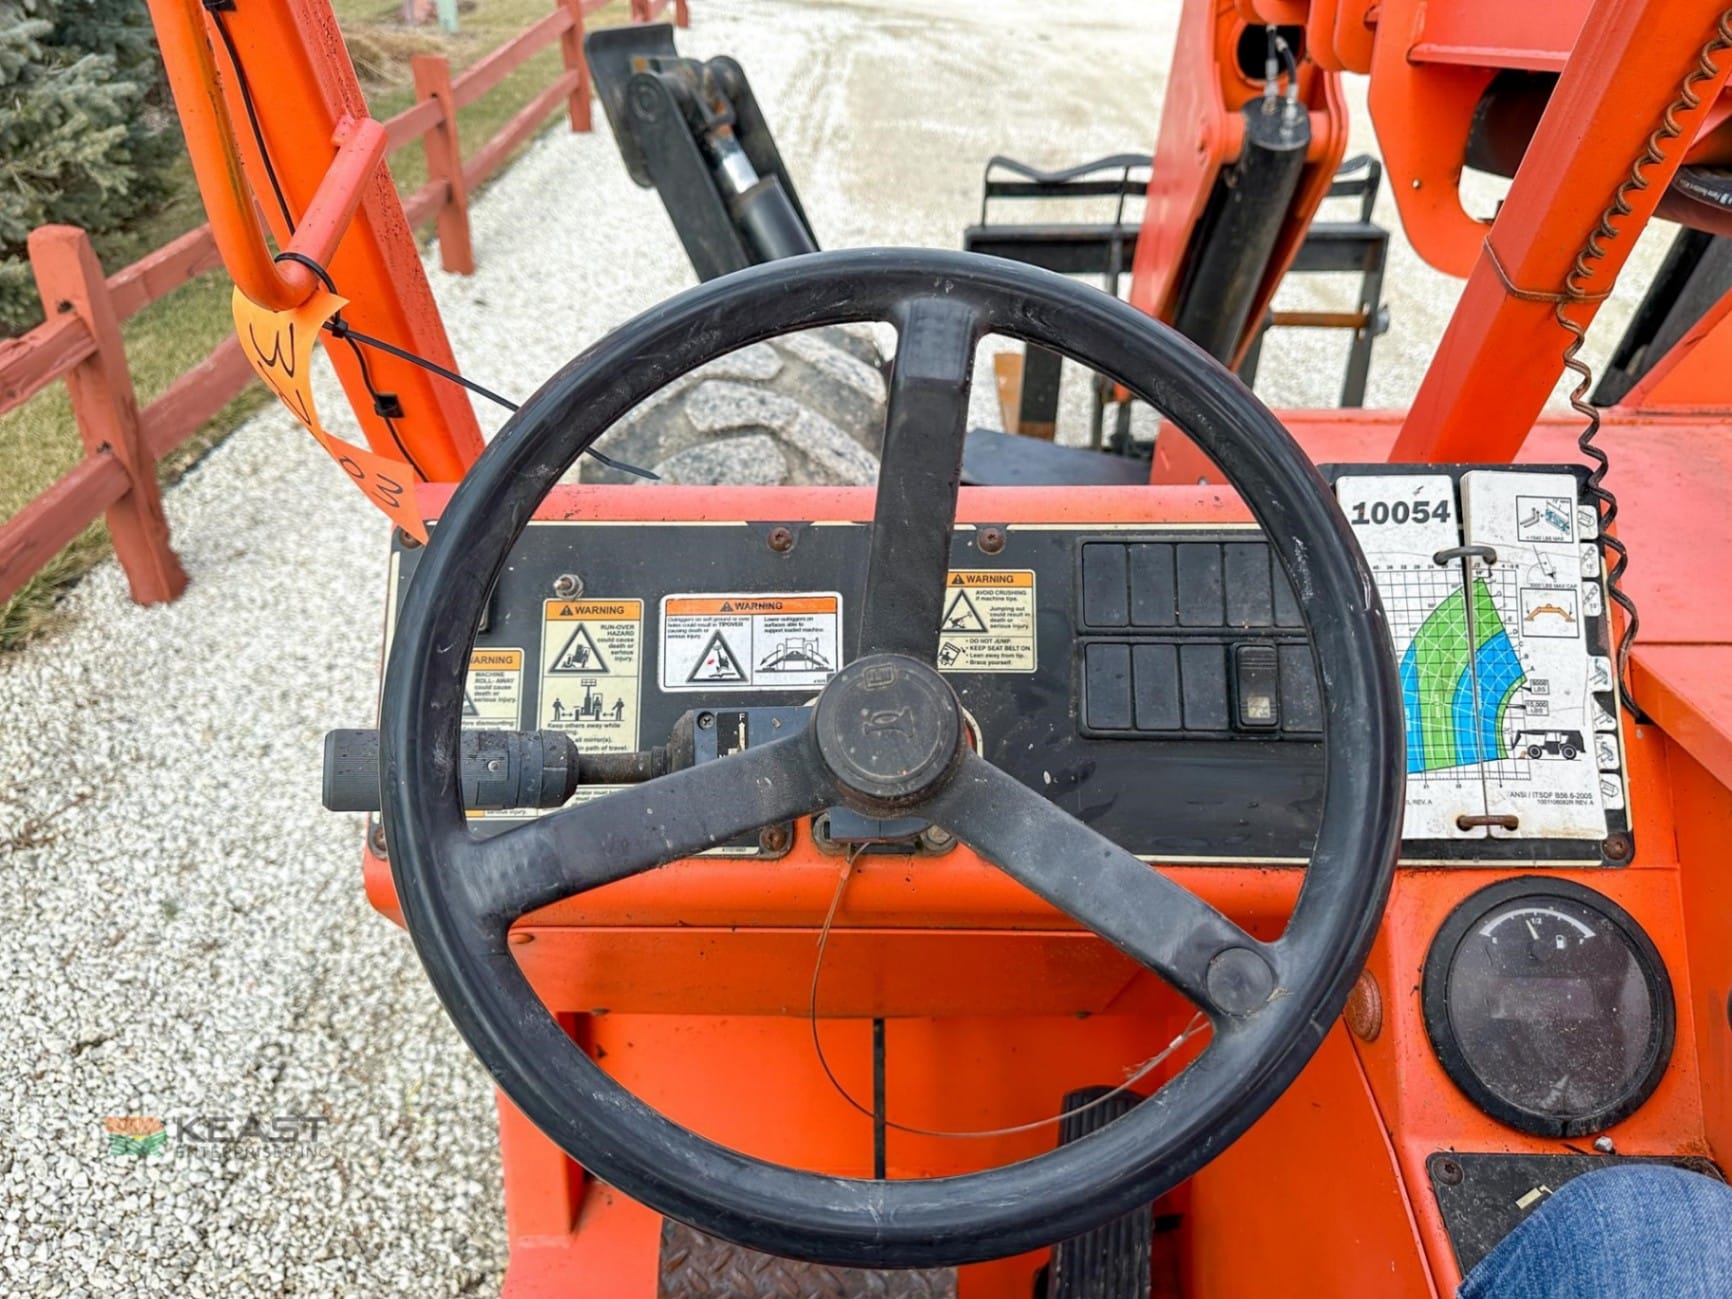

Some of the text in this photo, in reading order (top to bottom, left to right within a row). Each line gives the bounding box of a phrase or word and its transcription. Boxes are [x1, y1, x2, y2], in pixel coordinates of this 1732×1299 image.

[1351, 499, 1451, 525] 10054
[965, 575, 1014, 584] WARNING
[575, 605, 625, 615] WARNING
[735, 602, 783, 610] WARNING
[739, 713, 745, 721] F
